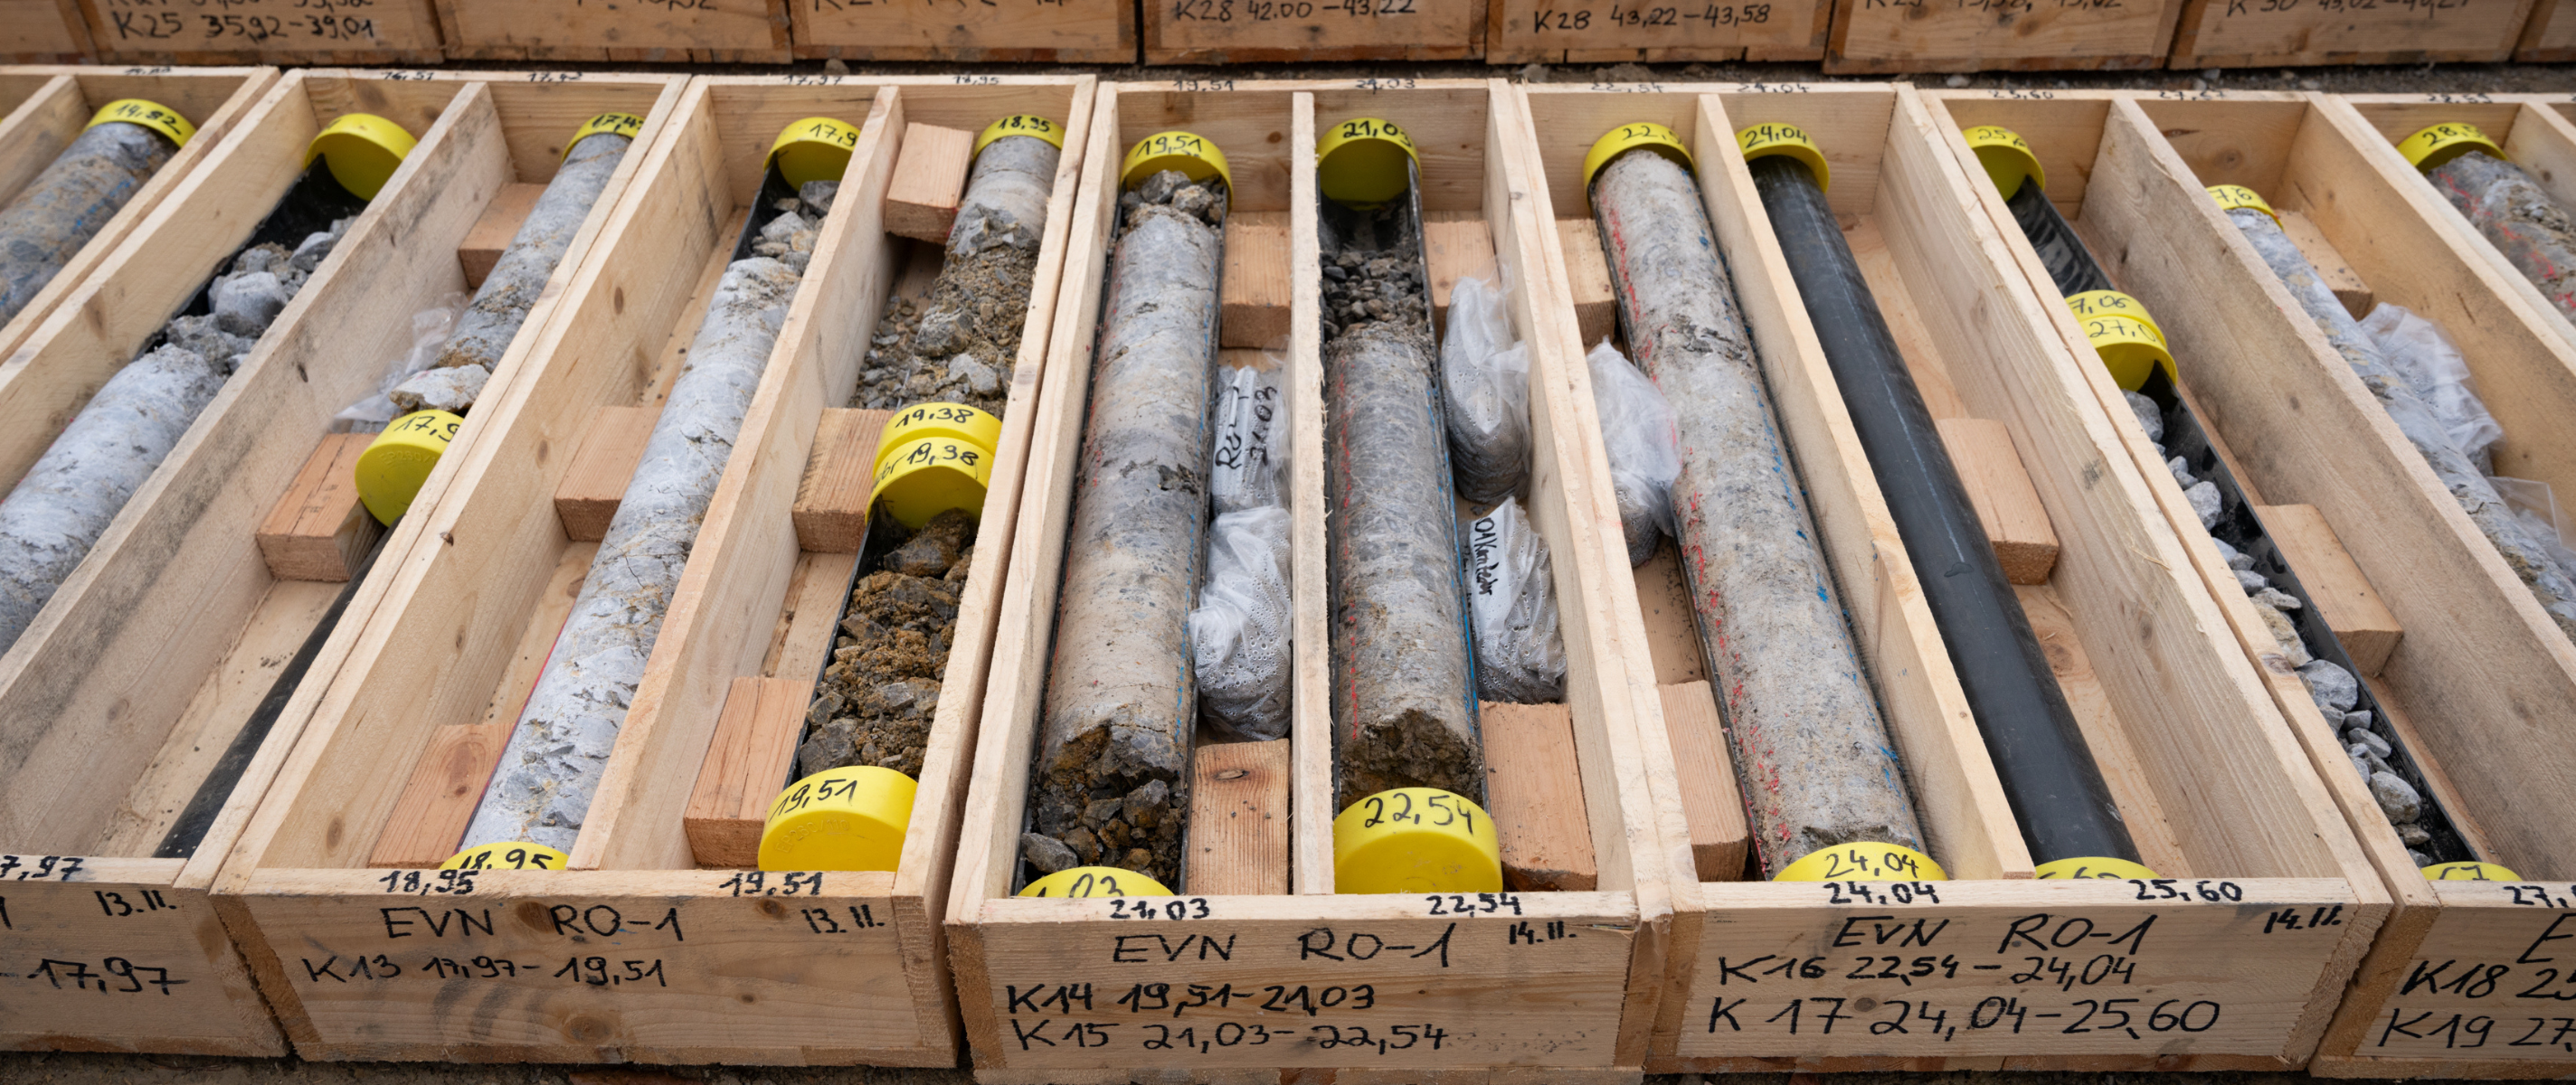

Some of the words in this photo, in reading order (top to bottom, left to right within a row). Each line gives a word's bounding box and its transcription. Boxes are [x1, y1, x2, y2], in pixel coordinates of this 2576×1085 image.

[996, 115, 1051, 134] 18,95
[1342, 119, 1413, 149] 21,03
[1744, 125, 1808, 149] 24,04
[1134, 135, 1203, 158] 19,51
[894, 407, 975, 429] 19,38
[906, 442, 980, 467] 19,38
[768, 778, 858, 824] 19,51
[1363, 792, 1475, 837] 22,54
[1823, 849, 1920, 879] 24,04
[380, 868, 479, 896] 18,95
[718, 871, 824, 898] 19,51
[1823, 881, 1940, 905] 24,04
[2128, 878, 2243, 903] 25,60
[1109, 897, 1211, 920] 21,03
[1425, 892, 1523, 919] 22,54
[379, 906, 495, 939] EVN
[549, 904, 684, 942] RO-1
[1832, 915, 1950, 948] EVN
[1997, 912, 2158, 956] RO-1
[1113, 933, 1237, 963] EVN
[1297, 922, 1457, 968] RO-1
[301, 954, 402, 984] K13
[1718, 954, 1827, 986] K16
[2399, 959, 2510, 999] K18
[1006, 982, 1094, 1014] K14
[2377, 1007, 2496, 1049] K19
